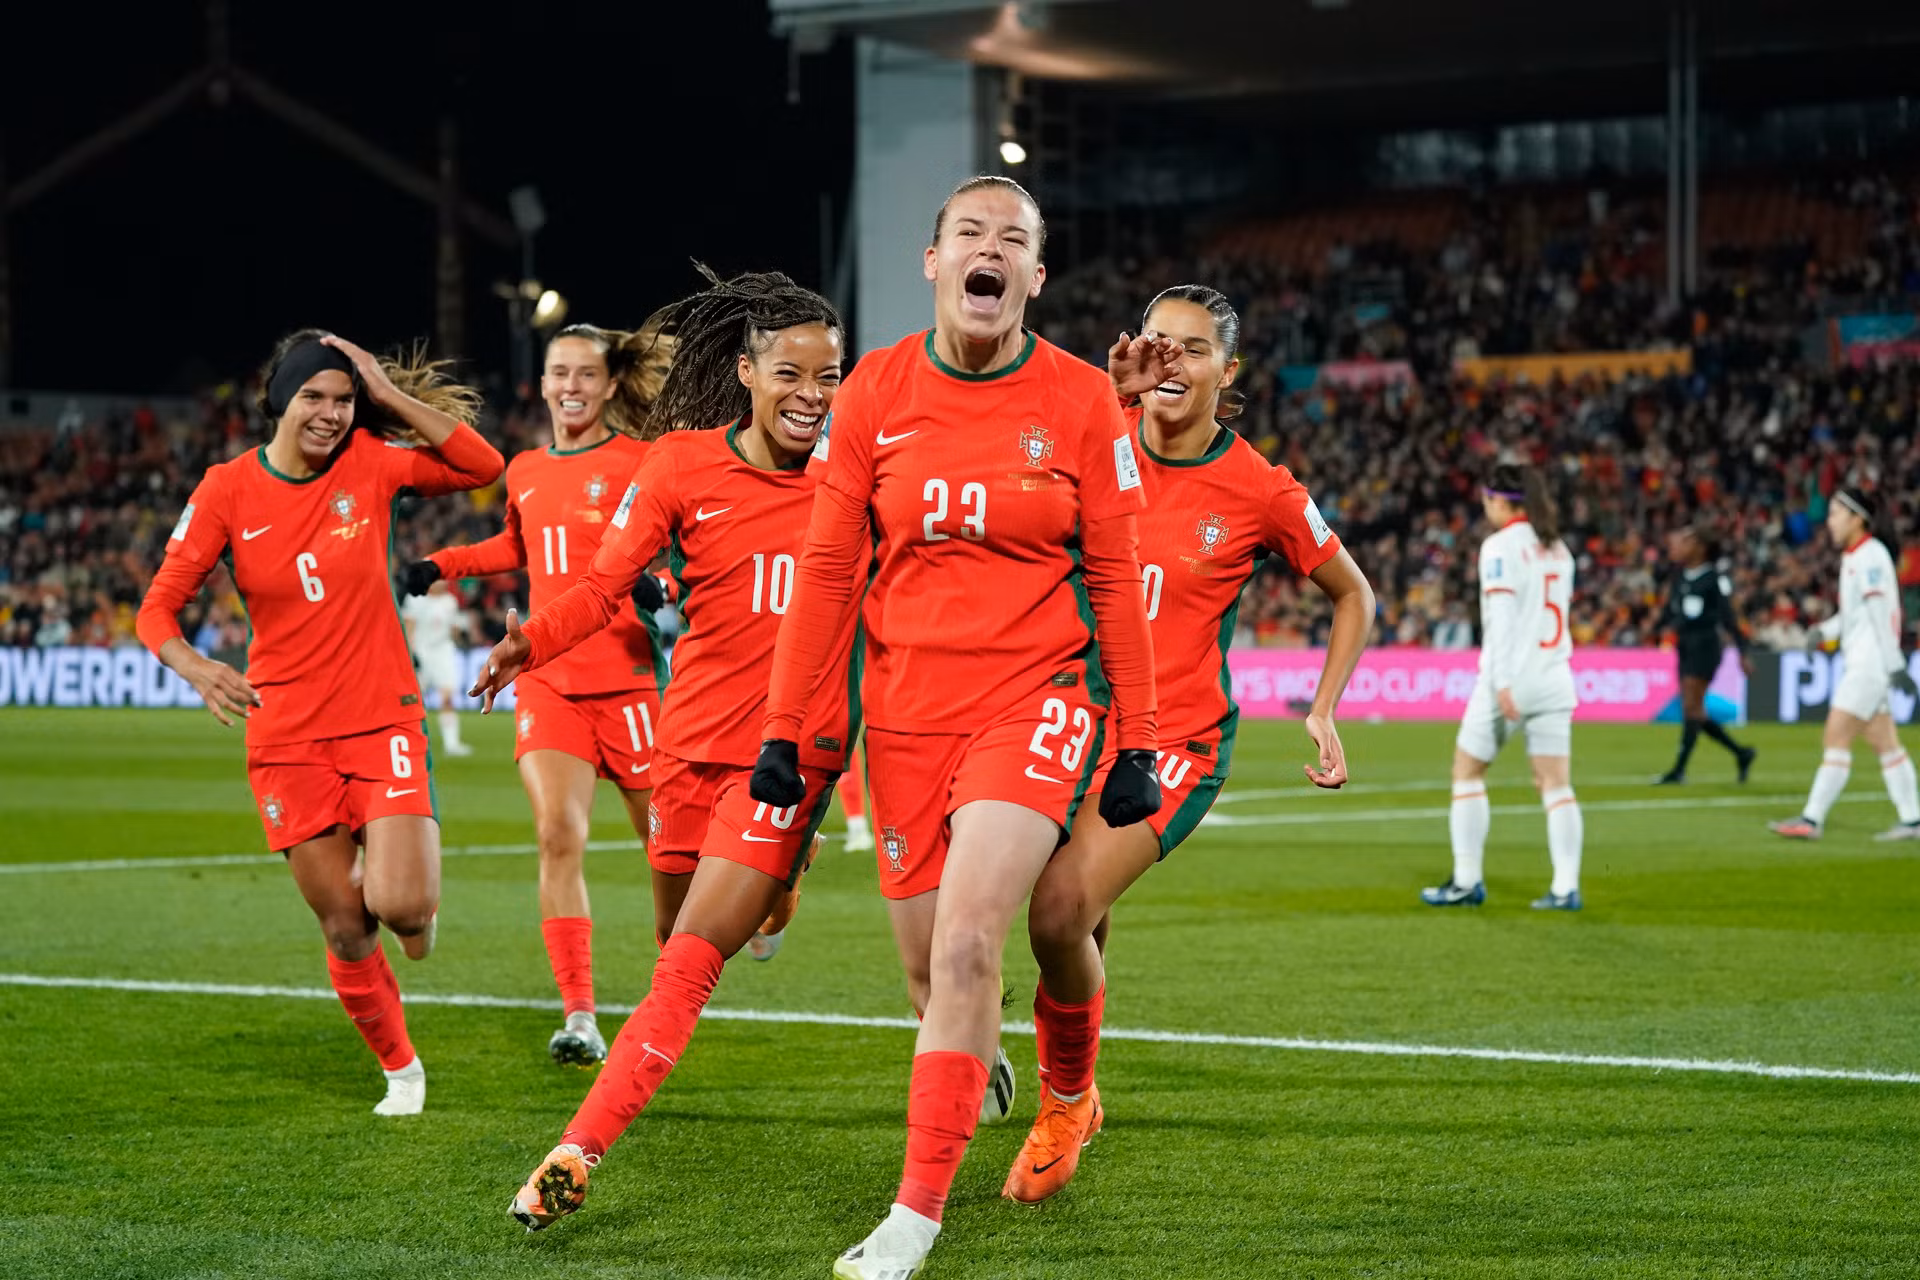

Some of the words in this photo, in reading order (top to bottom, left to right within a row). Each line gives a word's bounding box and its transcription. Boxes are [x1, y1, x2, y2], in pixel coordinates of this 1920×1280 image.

[923, 478, 987, 541] 23
[542, 525, 568, 575] 11
[296, 554, 325, 602] 6
[752, 553, 795, 615] 10
[1539, 572, 1563, 649] 5
[1382, 666, 1442, 702] CUP
[1574, 668, 1648, 704] 023
[622, 702, 654, 752] 11
[1028, 697, 1091, 772] 23
[389, 734, 412, 778] 6
